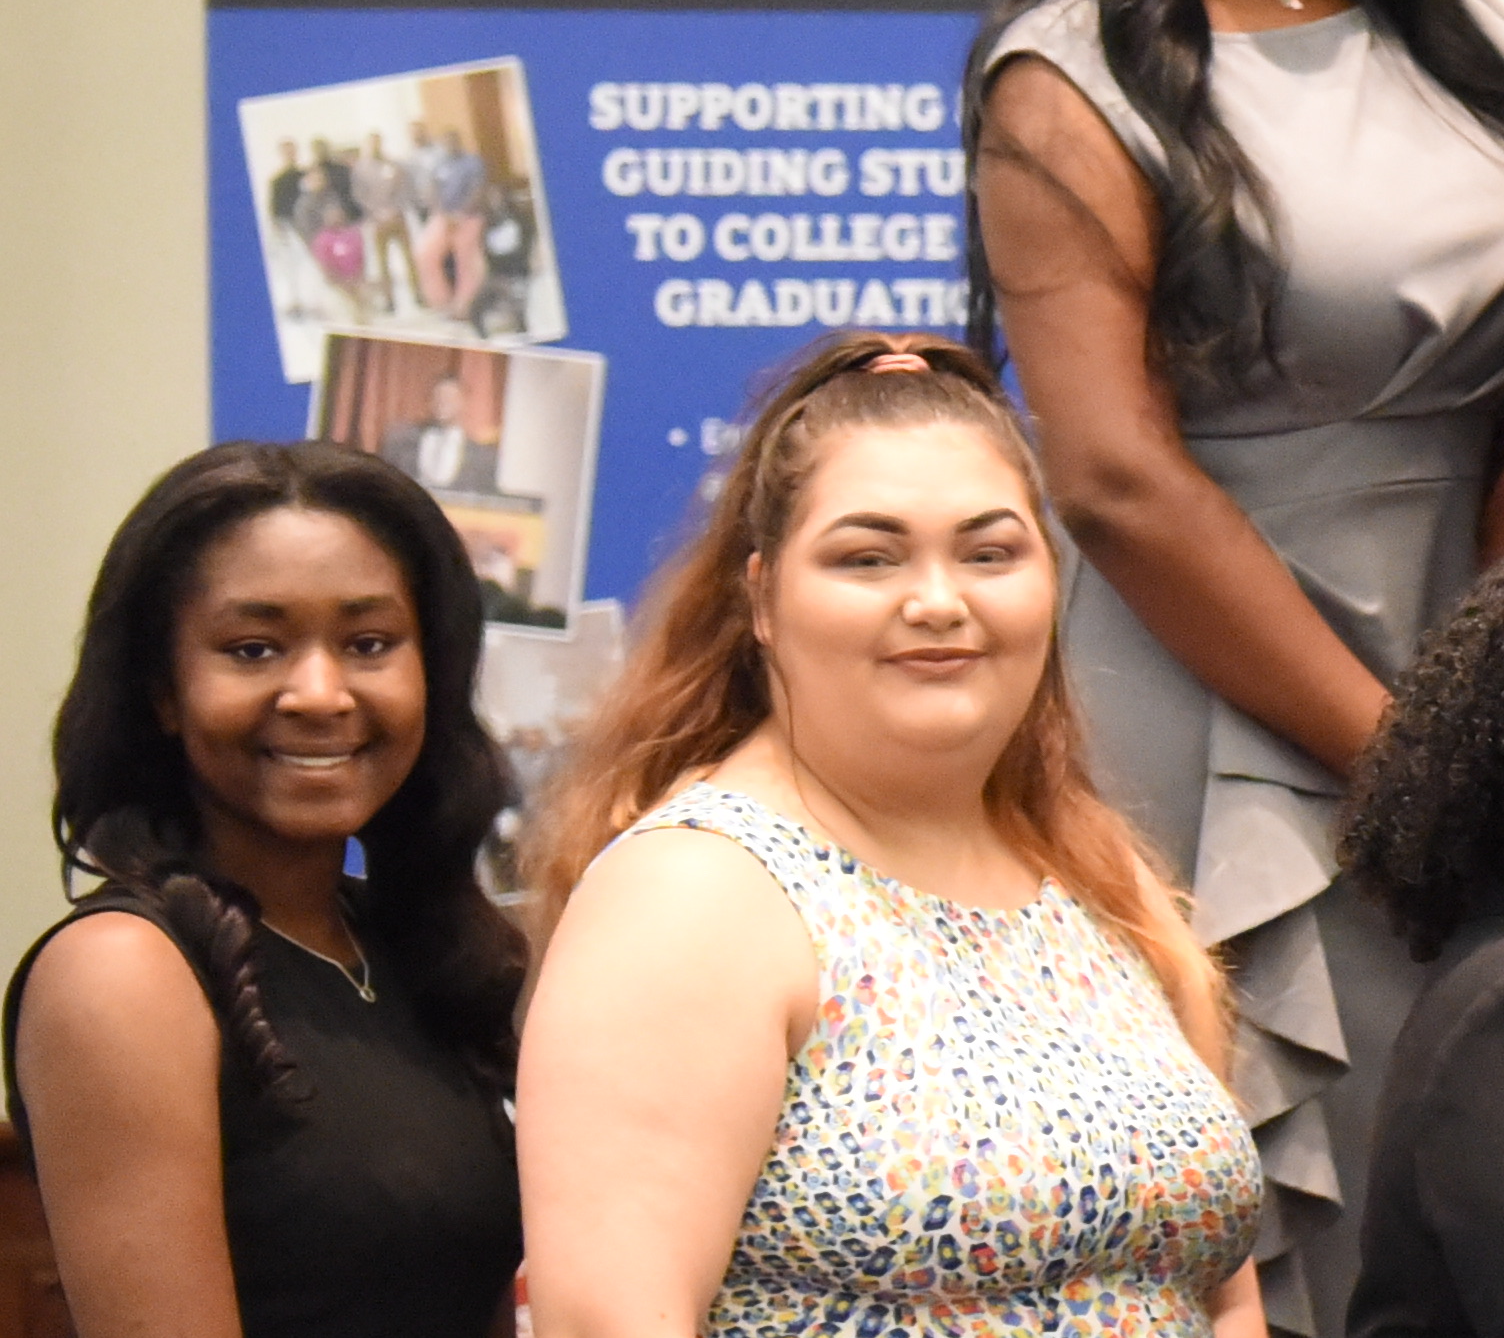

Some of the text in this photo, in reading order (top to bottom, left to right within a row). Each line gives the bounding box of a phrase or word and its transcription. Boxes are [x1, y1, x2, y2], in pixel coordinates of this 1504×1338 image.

[588, 82, 944, 132] SUPPORTING
[602, 146, 967, 197] GUIDING STU
[625, 212, 958, 262] TO COLLEGE
